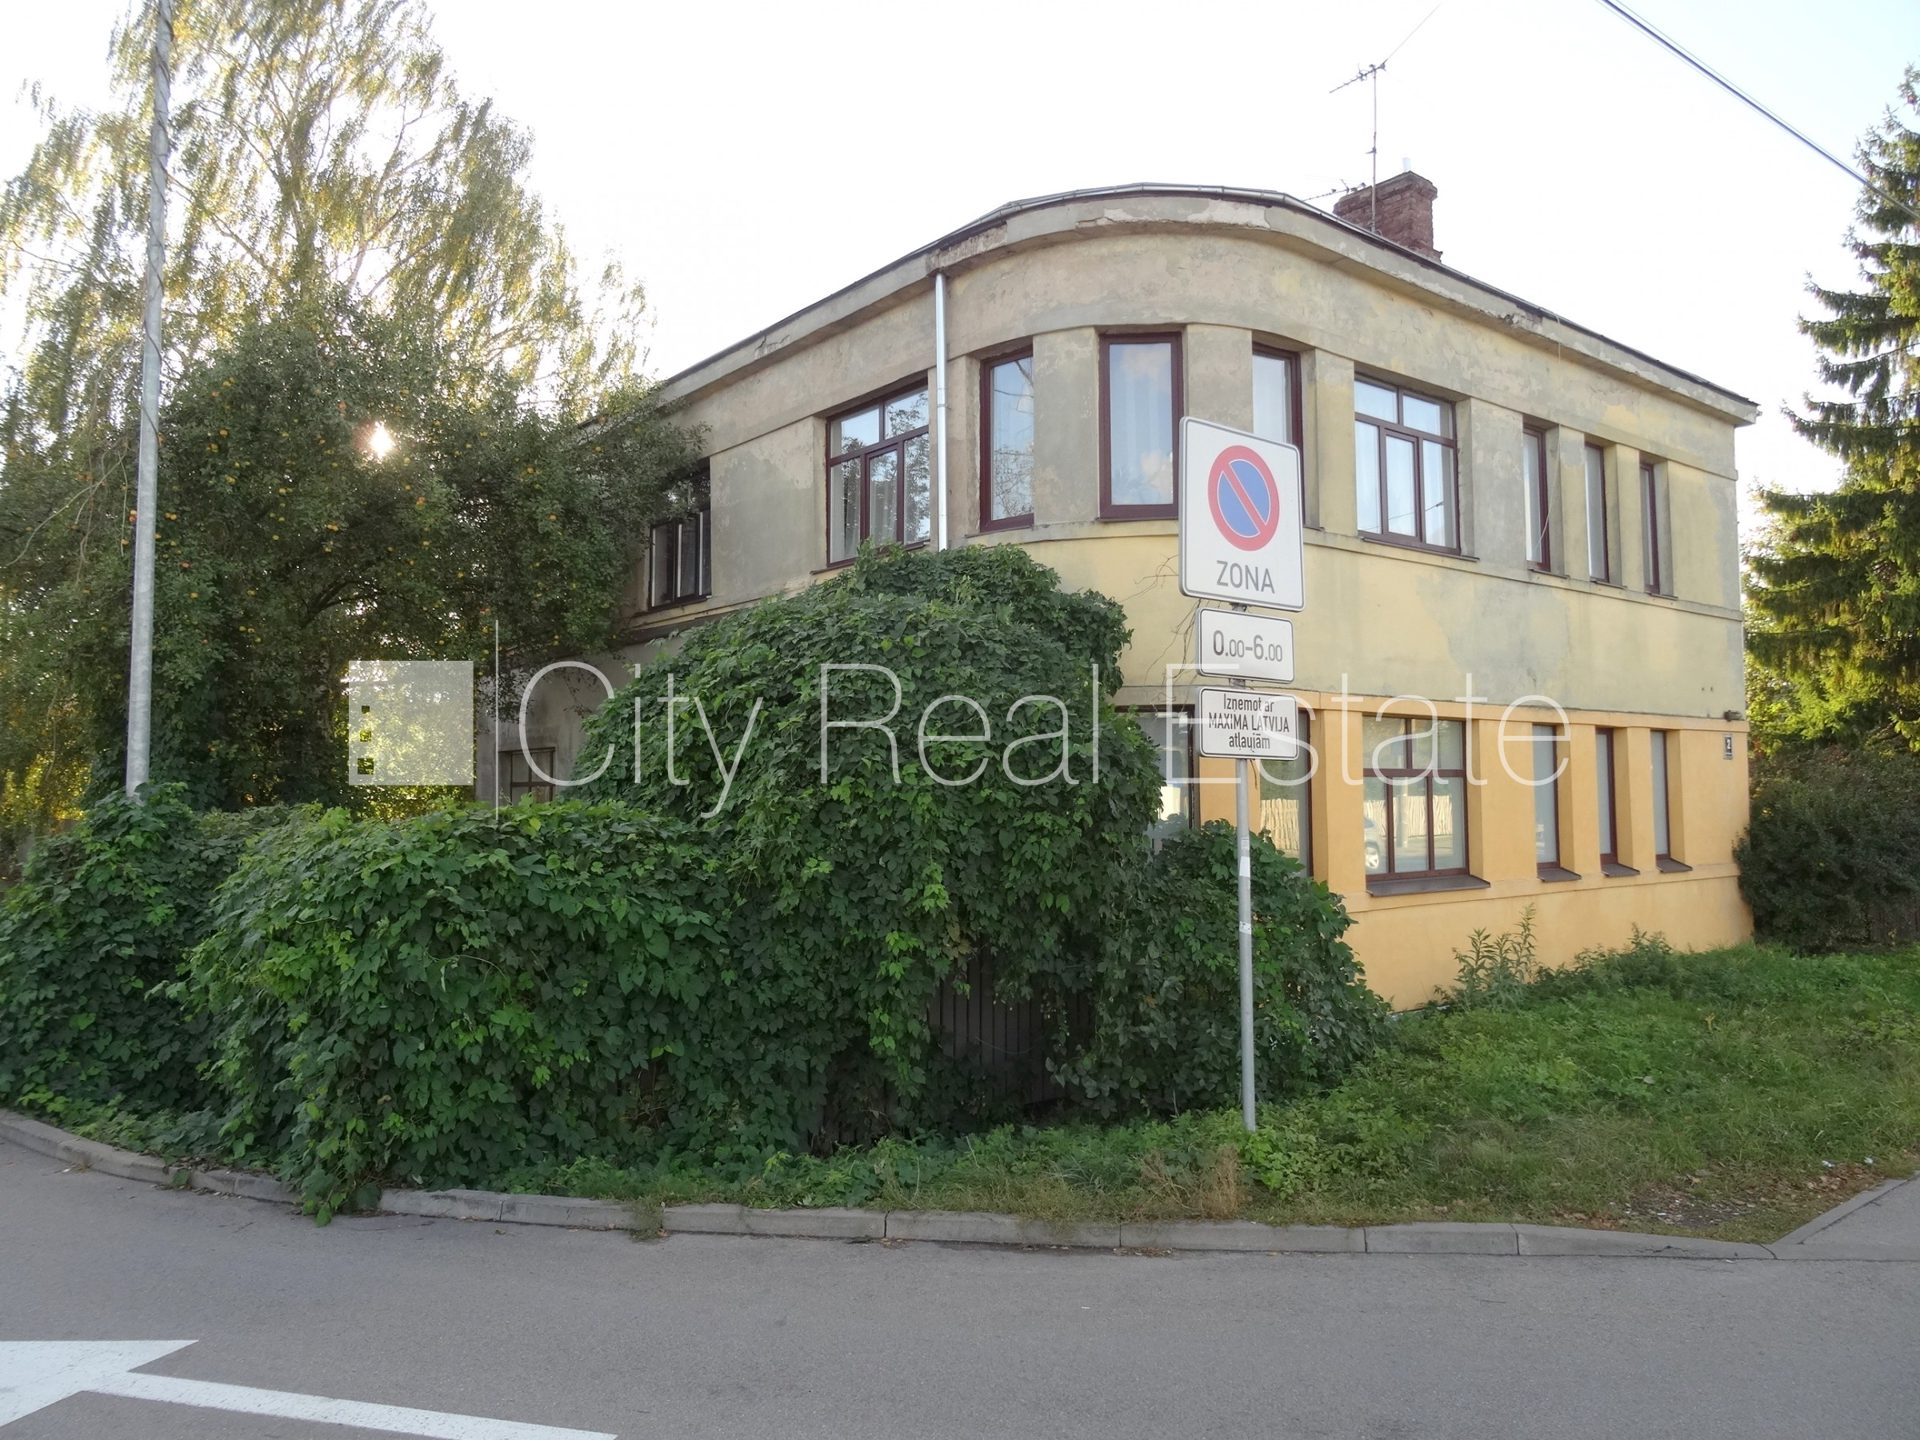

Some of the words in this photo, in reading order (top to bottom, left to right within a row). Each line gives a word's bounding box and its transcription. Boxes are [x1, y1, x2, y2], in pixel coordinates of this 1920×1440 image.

[1217, 561, 1275, 594] ZONA
[1213, 630, 1283, 662] 0.00-6.00
[1264, 701, 1274, 712] ar
[1208, 712, 1249, 731] MAXIMA
[1251, 715, 1290, 733] LATVIJA
